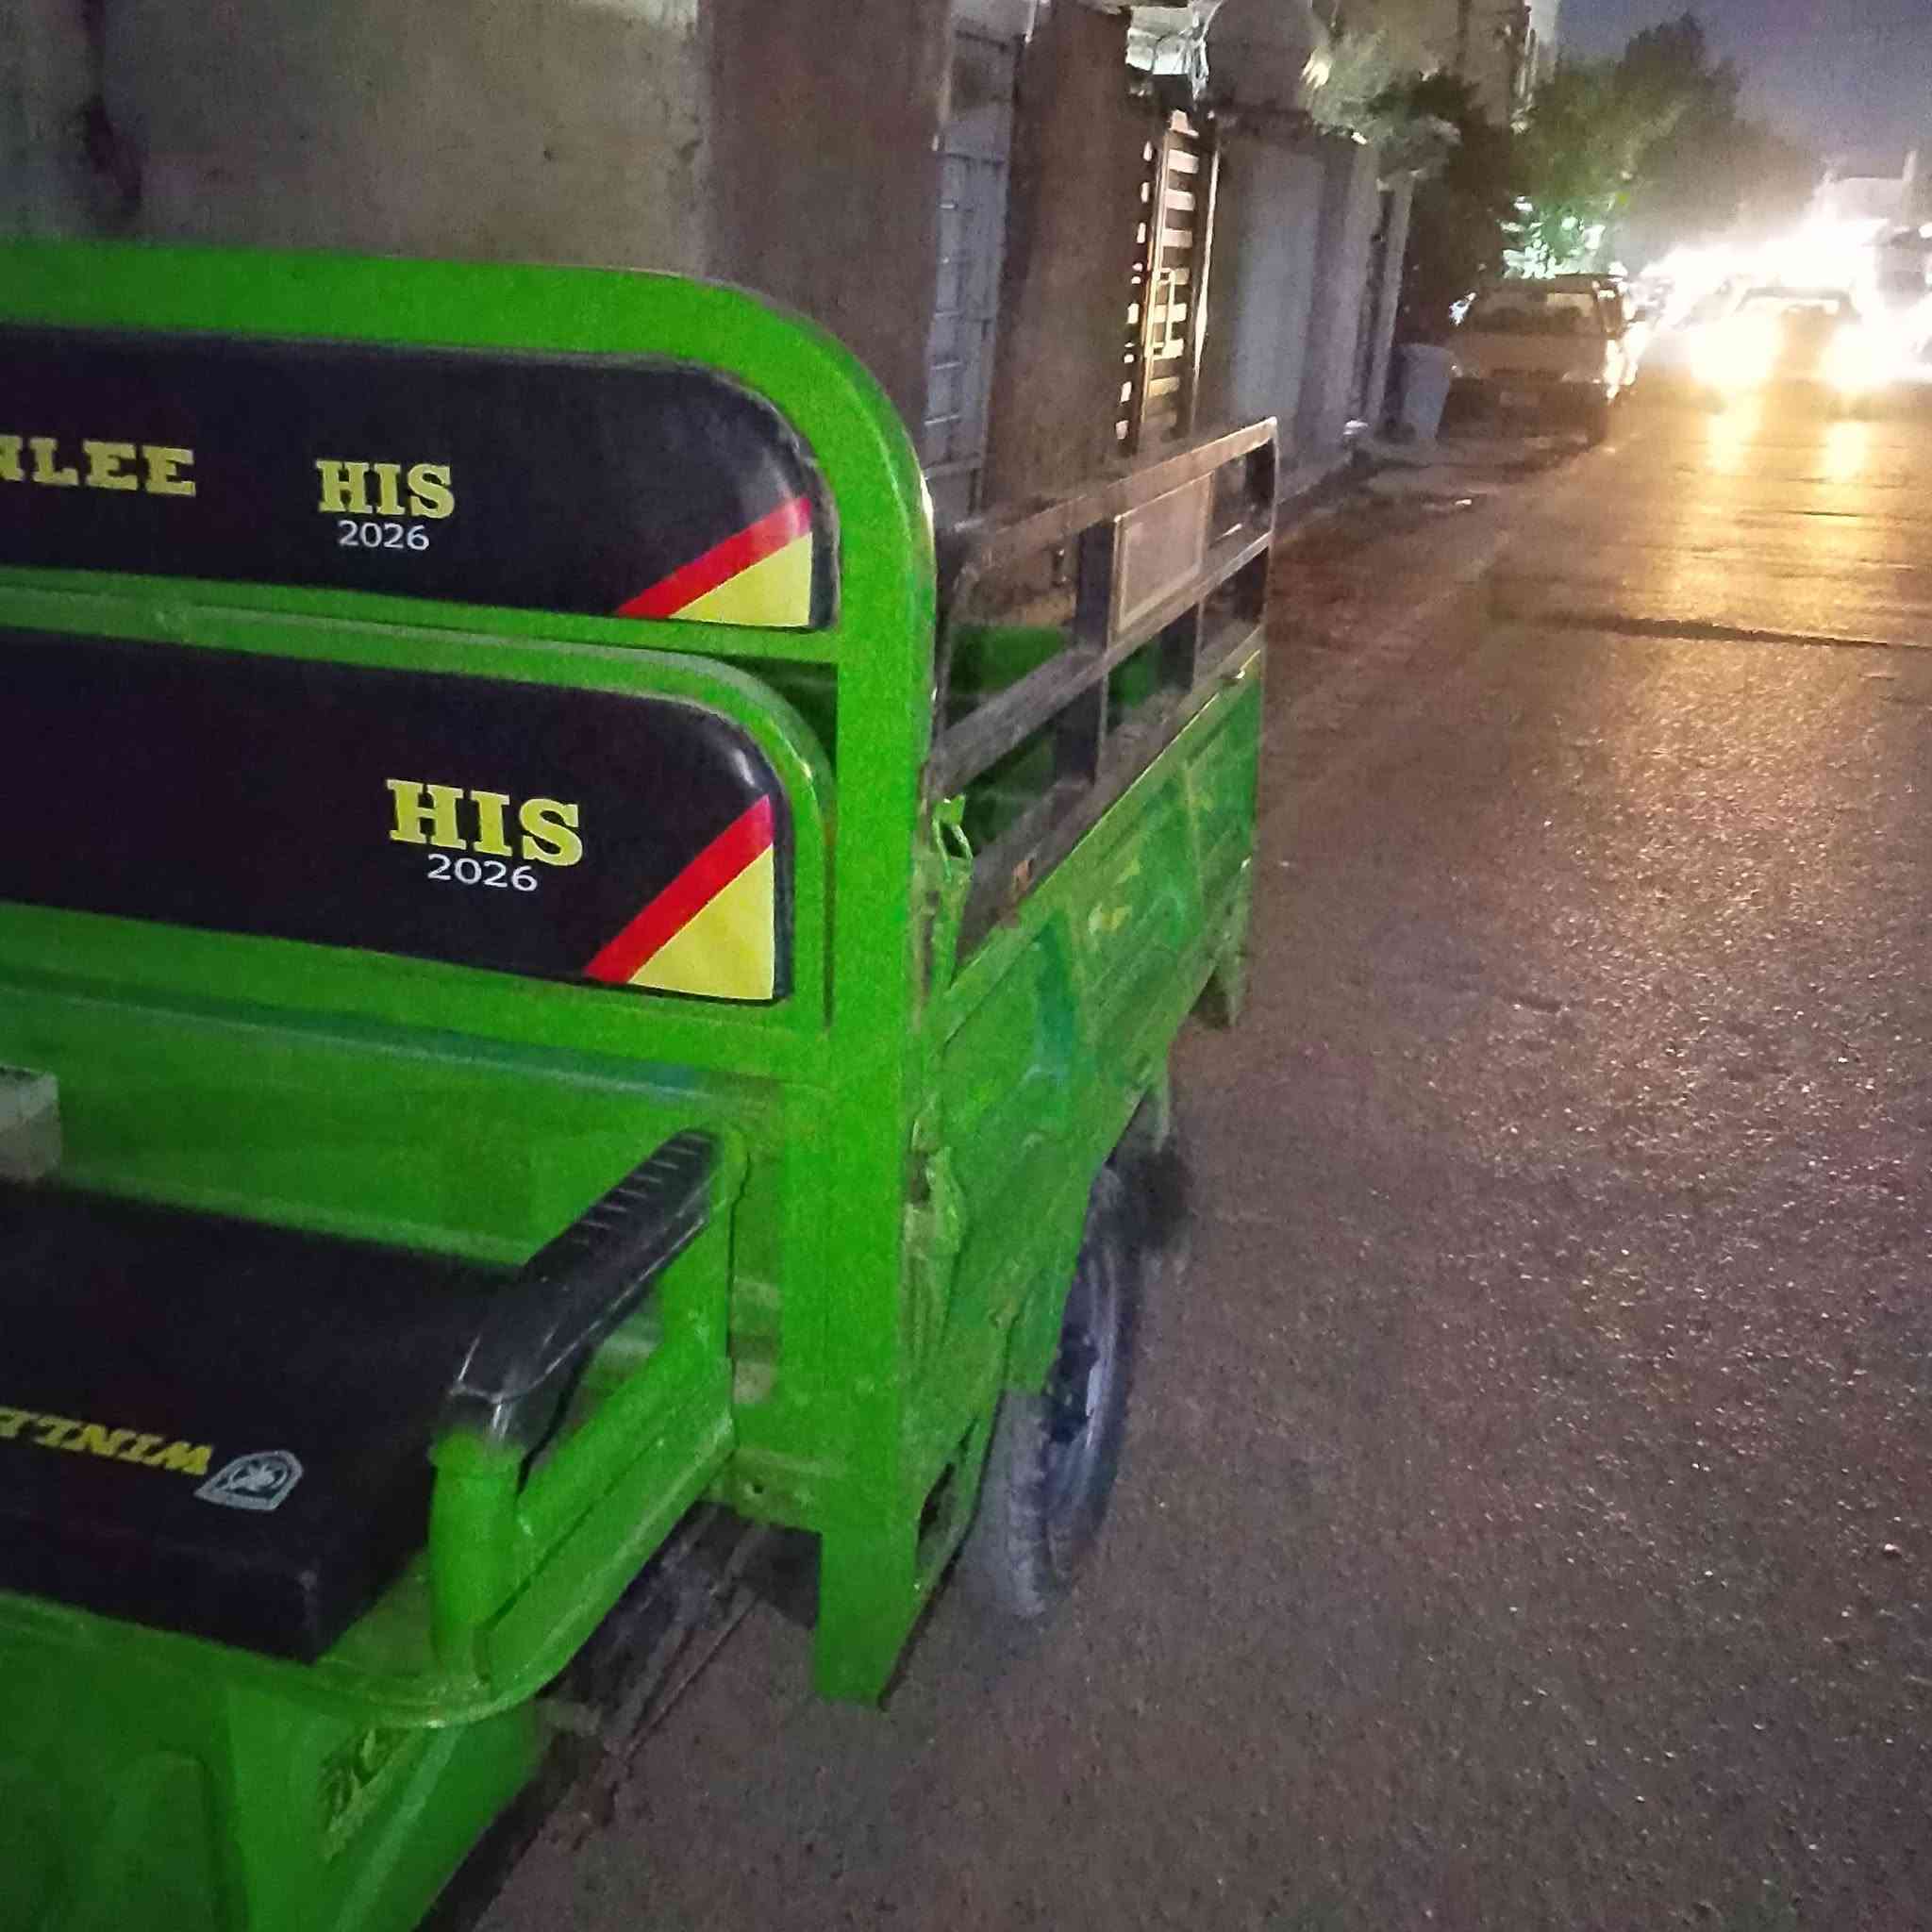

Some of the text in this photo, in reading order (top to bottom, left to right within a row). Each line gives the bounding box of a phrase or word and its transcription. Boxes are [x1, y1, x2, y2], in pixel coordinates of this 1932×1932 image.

[315, 459, 455, 519] HIS
[337, 520, 430, 551] 2026
[386, 779, 583, 867] HIS
[427, 853, 539, 891] 2026
